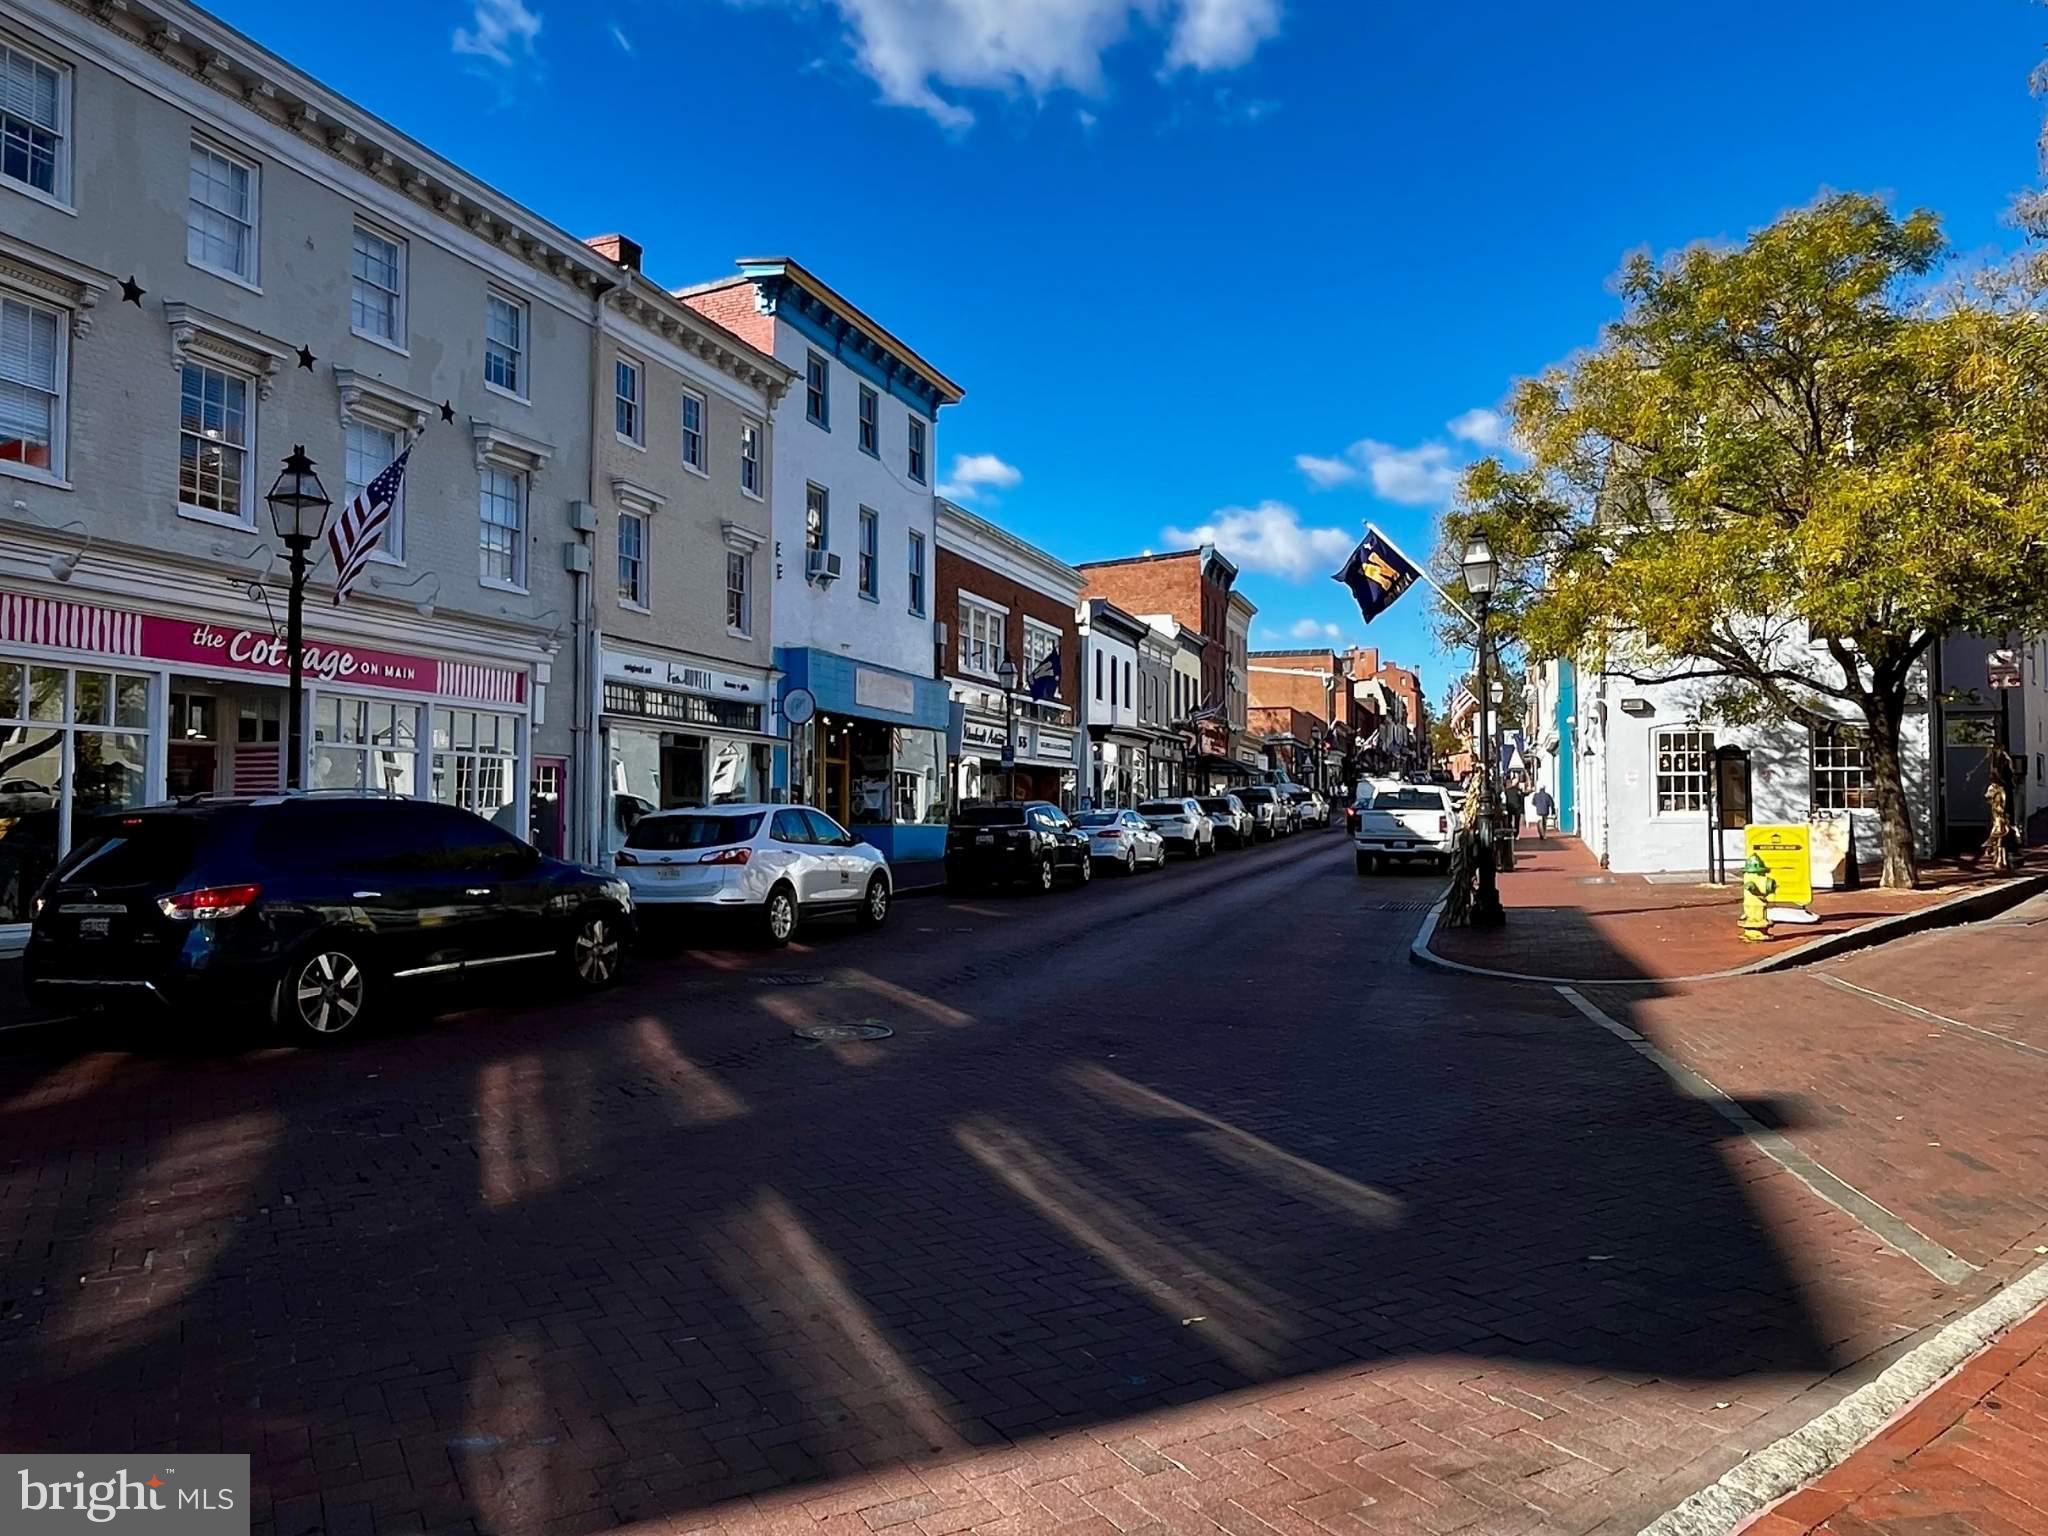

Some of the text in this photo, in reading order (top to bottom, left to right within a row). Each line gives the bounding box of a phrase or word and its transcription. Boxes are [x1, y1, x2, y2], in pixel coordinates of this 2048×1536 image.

[192, 625, 415, 681] the Cotage ON MAIN
